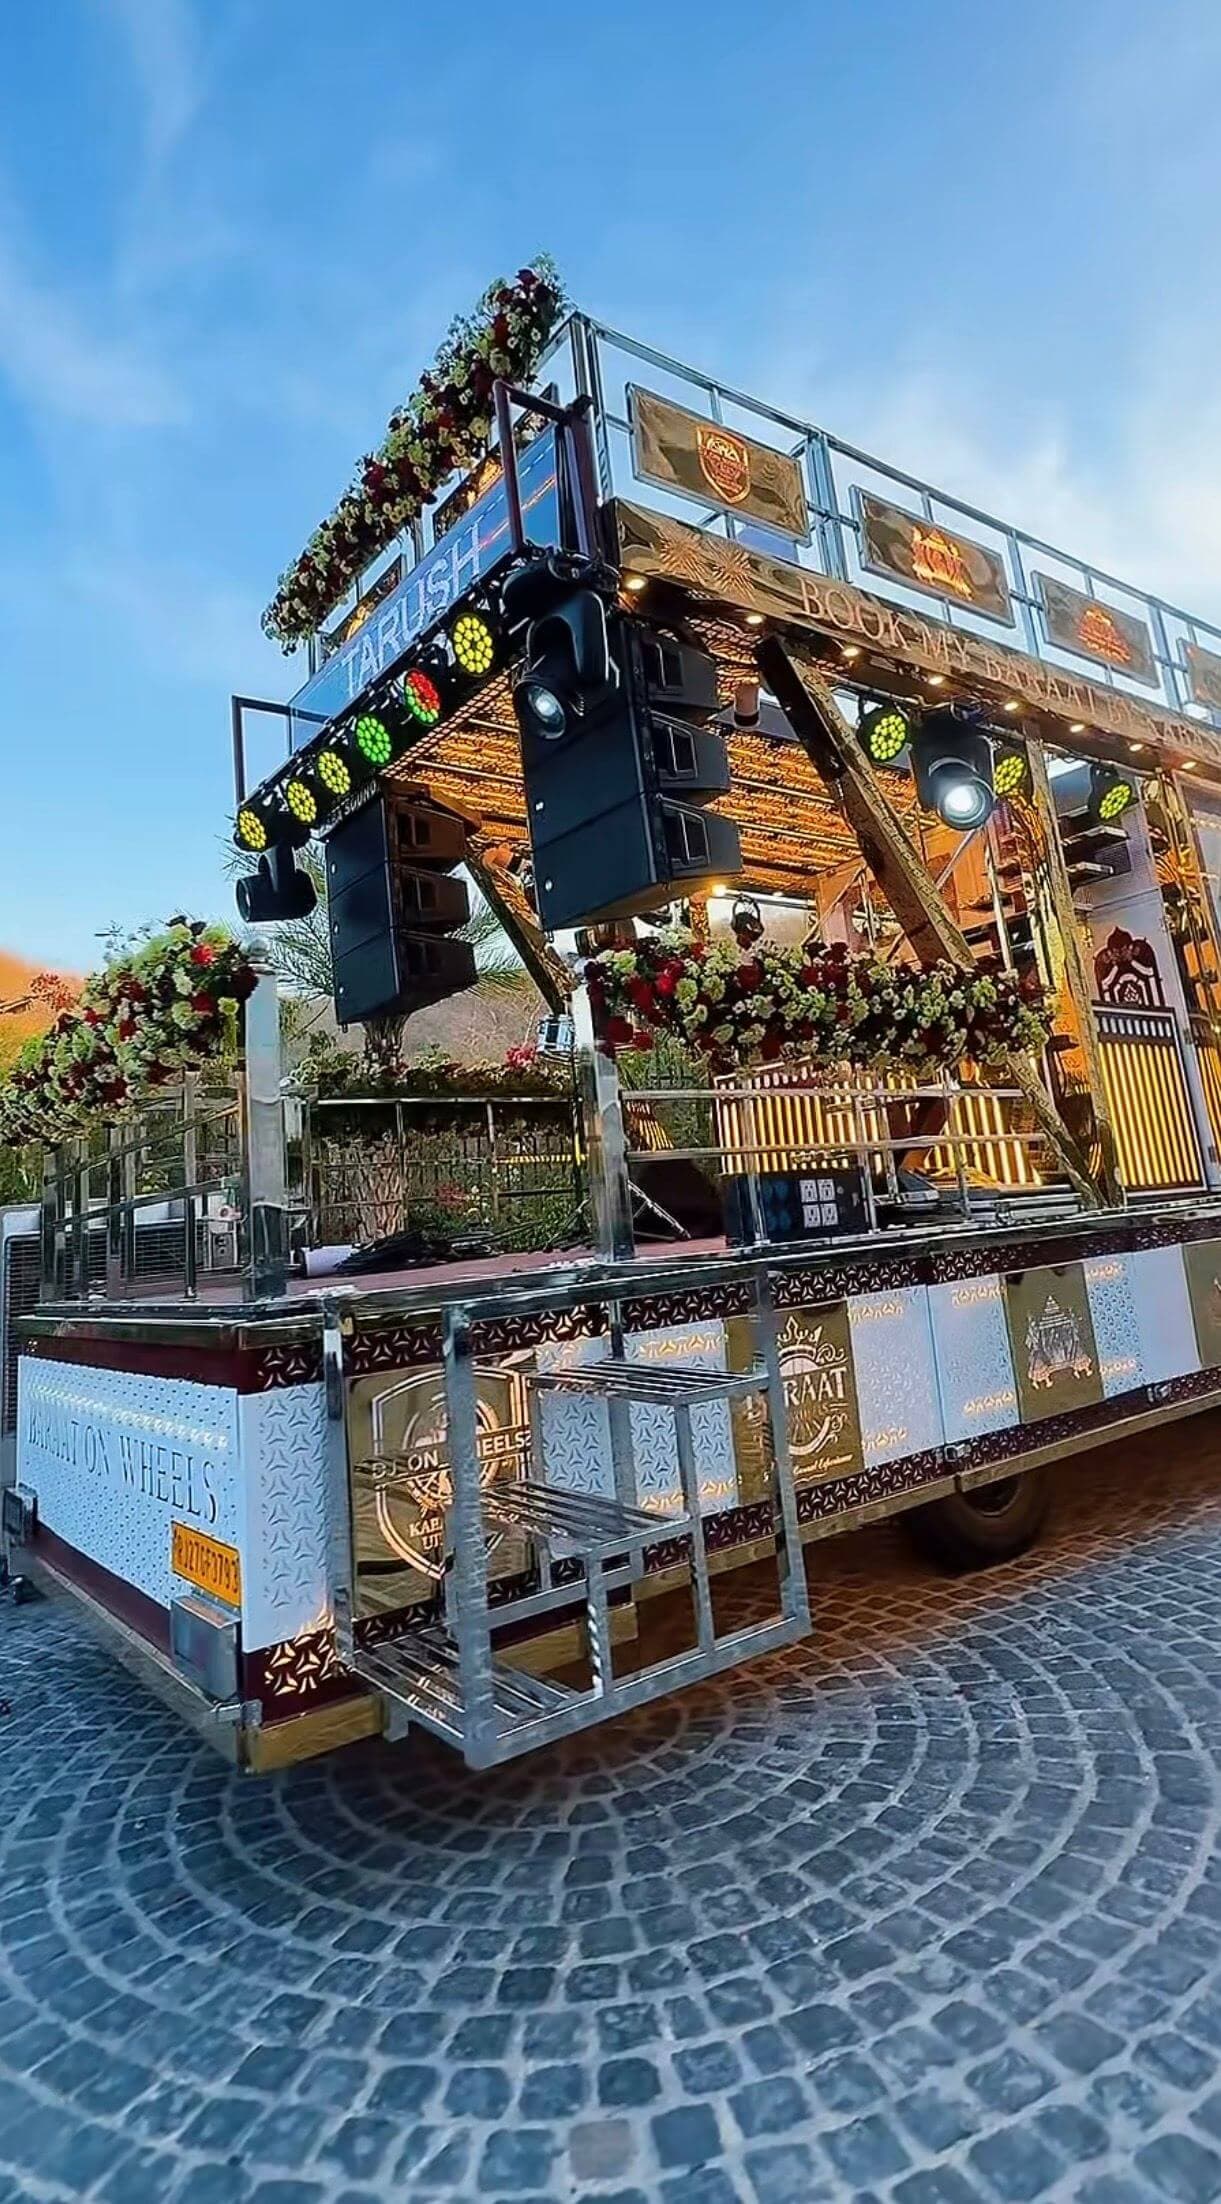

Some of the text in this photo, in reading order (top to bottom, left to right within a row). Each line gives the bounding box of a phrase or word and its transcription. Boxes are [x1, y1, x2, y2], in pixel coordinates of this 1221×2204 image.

[343, 520, 480, 699] TARUSH
[797, 574, 911, 651] BOOK
[921, 620, 972, 672] MY
[781, 1366, 848, 1409] RAAT
[119, 1434, 218, 1525] WHEELS
[406, 1449, 440, 1473] ON
[475, 1430, 526, 1459] EELS
